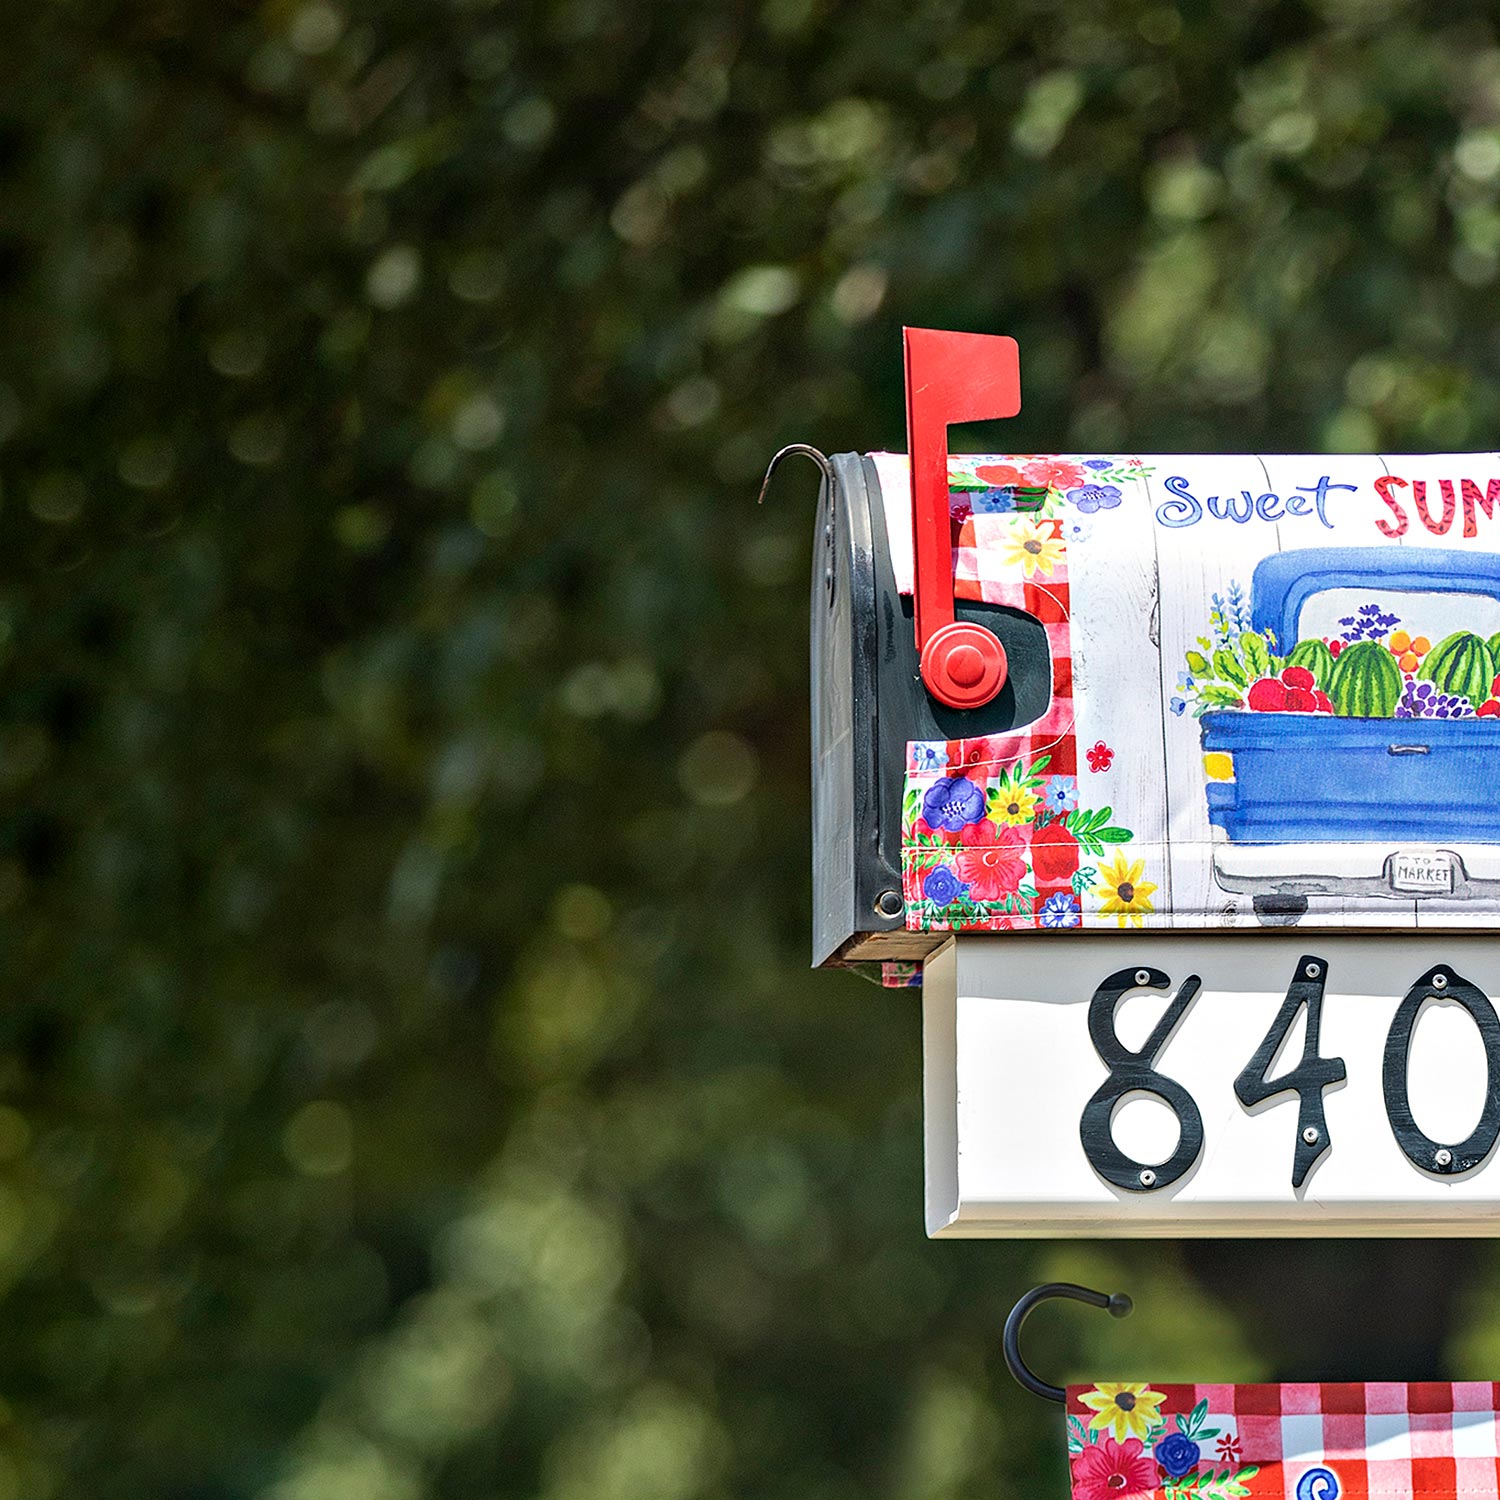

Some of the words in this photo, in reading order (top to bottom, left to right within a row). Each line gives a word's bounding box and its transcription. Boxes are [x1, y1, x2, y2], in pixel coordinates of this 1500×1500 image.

[1156, 475, 1358, 528] Sweet
[1412, 857, 1431, 865] TO
[1398, 866, 1449, 881] MARKET
